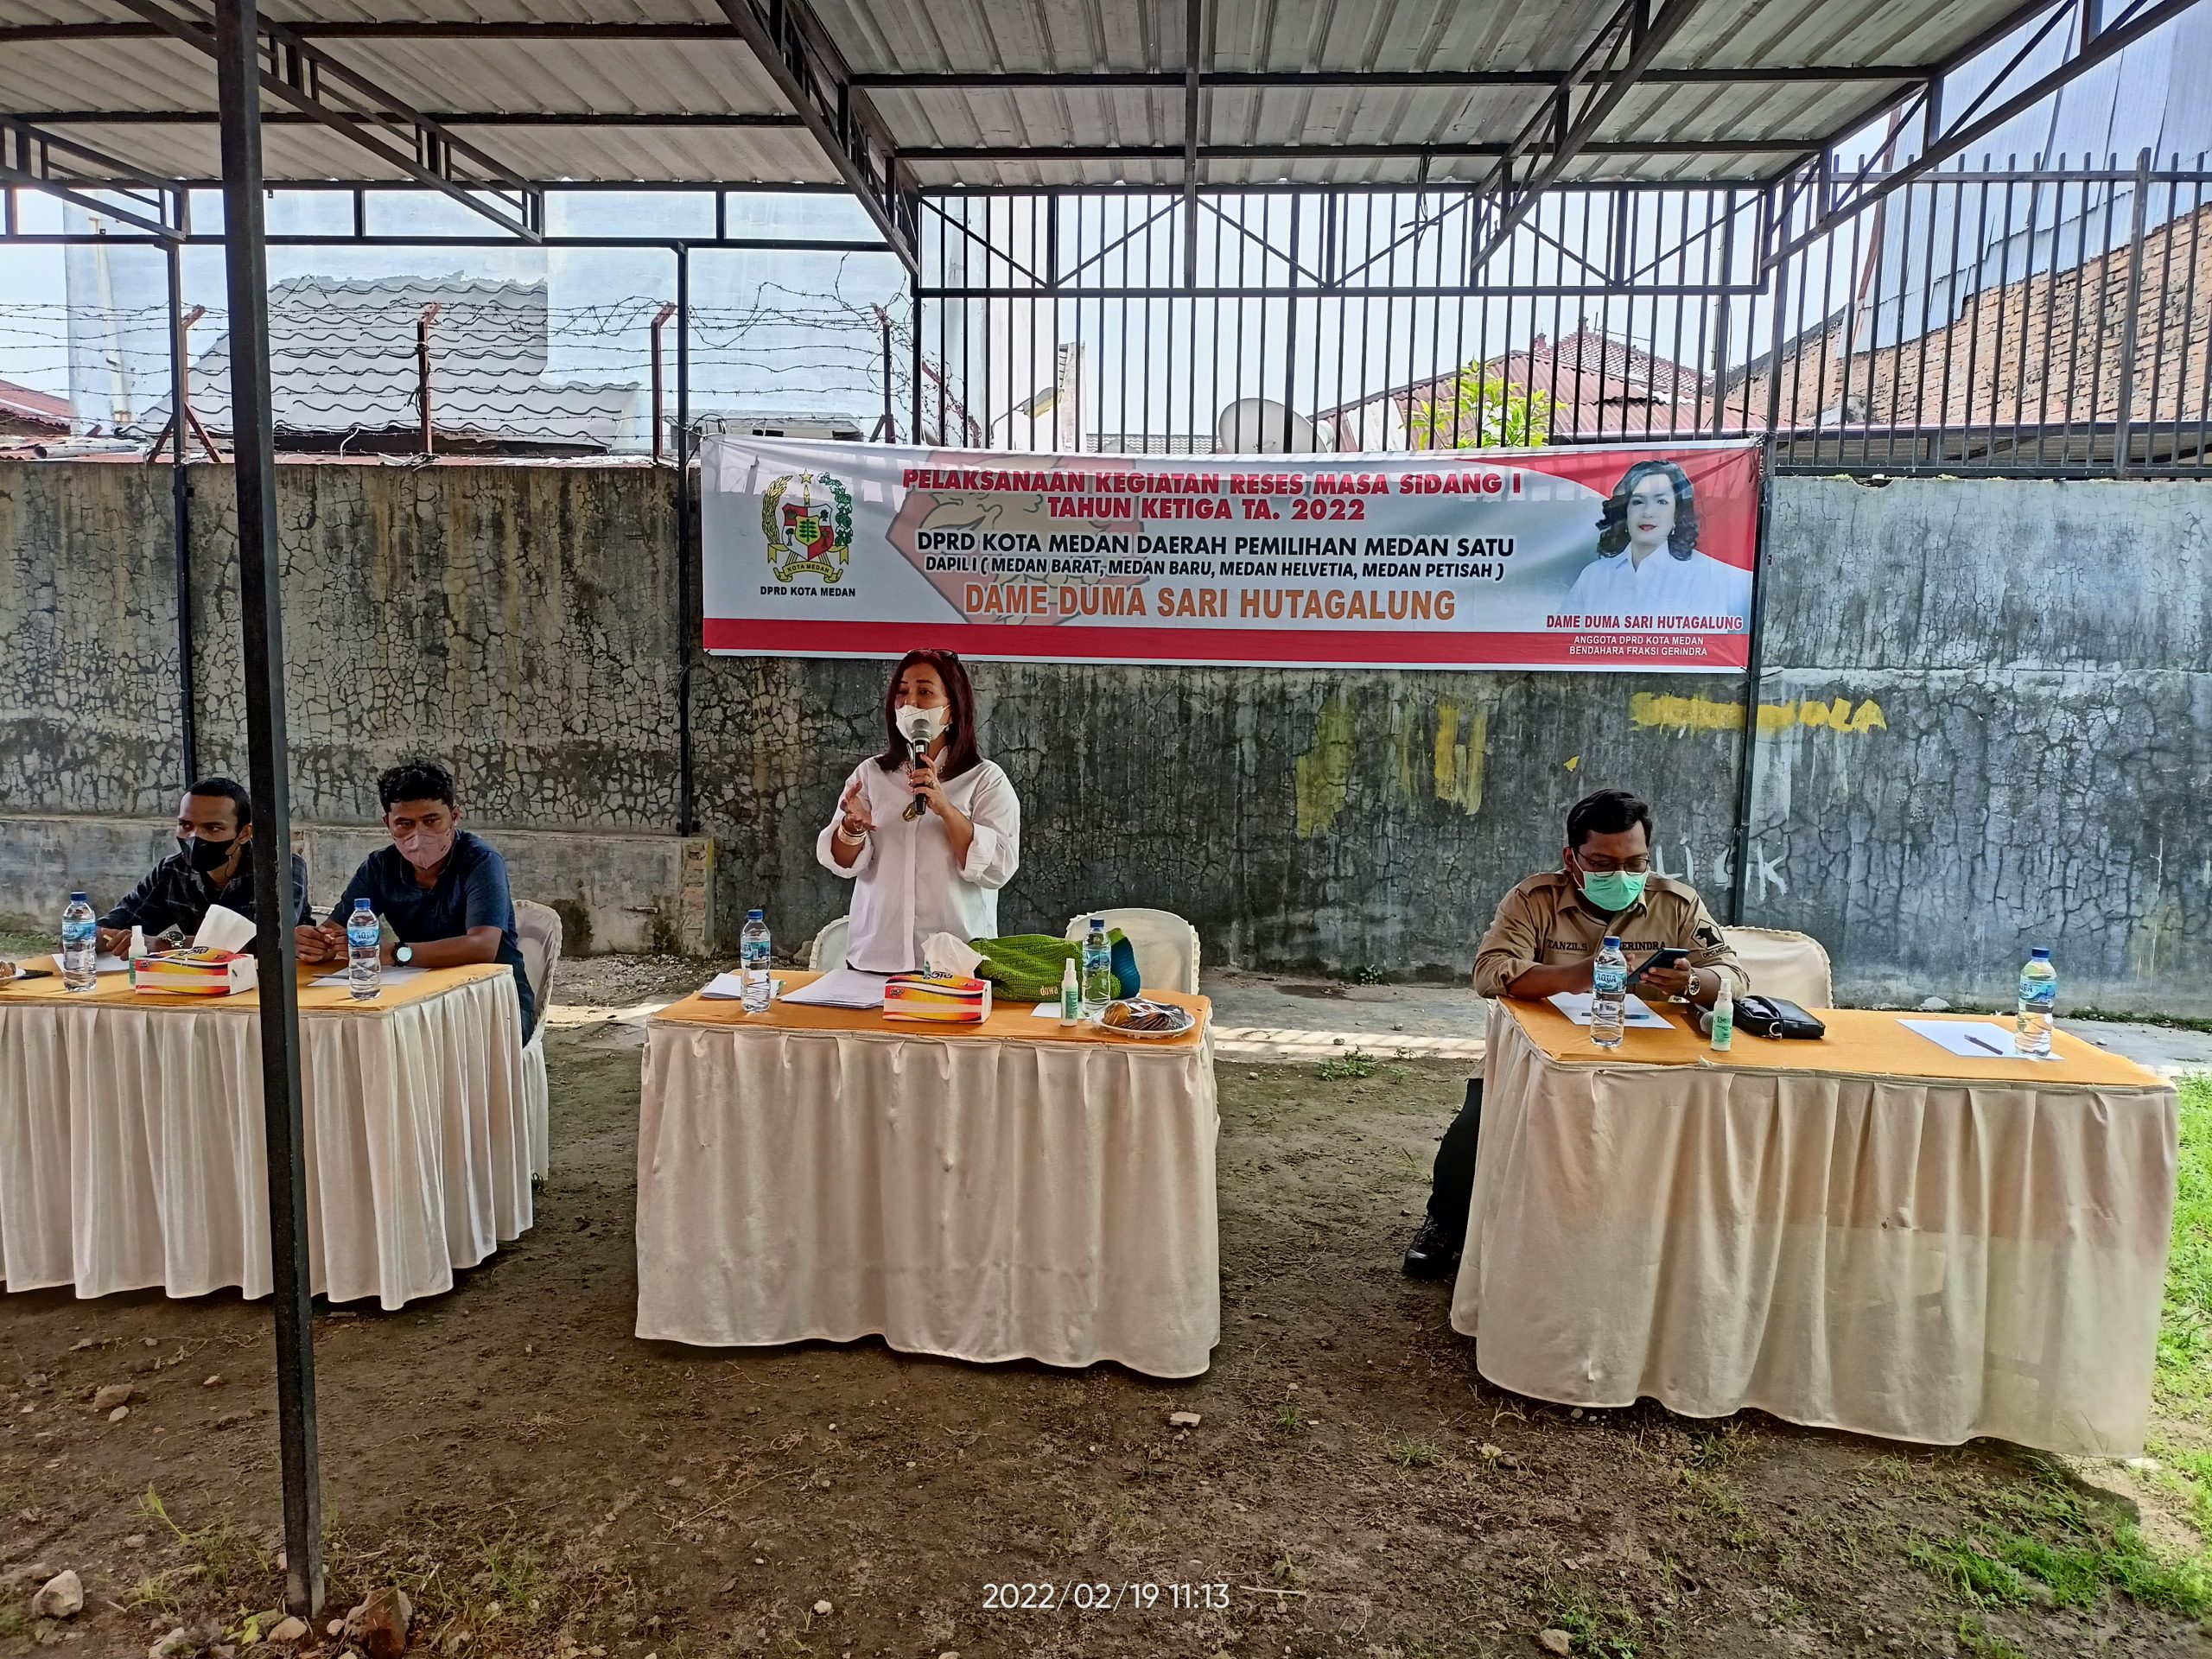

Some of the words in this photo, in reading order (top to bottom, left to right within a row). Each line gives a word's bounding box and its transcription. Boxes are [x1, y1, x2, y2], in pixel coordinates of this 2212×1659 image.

[903, 469, 1085, 493] PELAKSANAAN
[1095, 472, 1219, 494] KEGIATAN
[1230, 474, 1304, 494] RESES
[1313, 474, 1389, 495] MASA
[1399, 474, 1503, 495] SIDANG
[1513, 473, 1522, 493] I
[1047, 497, 1131, 518] TAHUN
[1141, 498, 1232, 519] KETIGA
[1242, 499, 1281, 520] TA.
[1291, 499, 1365, 520] 2022
[918, 531, 975, 550] DPRD
[982, 533, 1041, 552] KOTA
[1049, 534, 1128, 554] MEDAN
[1137, 536, 1227, 555] DAERAH
[1235, 537, 1357, 556] PEMILIHAN
[1364, 537, 1448, 556] MEDAN
[1457, 538, 1514, 557] SATU
[806, 564, 830, 573] MEDAN
[925, 556, 968, 571] DAPIL
[991, 557, 1047, 573] MEDAN
[1051, 558, 1104, 577] BARAT,
[1109, 559, 1165, 575] MEDAN
[1169, 560, 1216, 578] BARU,
[1219, 562, 1277, 576] MEDAN
[1281, 563, 1357, 580] HELVETIA,
[1362, 563, 1421, 577] MEDAN
[1426, 563, 1492, 578] PETISAH
[760, 586, 787, 595] DPRD
[791, 587, 817, 596] KOTA
[821, 588, 855, 597] MEDAN
[966, 584, 1047, 614] DAME
[1059, 586, 1147, 616] DUMA
[1157, 588, 1228, 617] SARI
[1240, 588, 1455, 620] HUTAGALUNG
[1547, 614, 1580, 628] DAME
[1585, 615, 1620, 629] DUMA
[1624, 615, 1653, 629] SARI
[1657, 616, 1743, 630] HUTAGALUNG
[1574, 635, 1616, 645] ANGGOTA
[1619, 636, 1643, 645] DPRD
[1672, 637, 1704, 645] MEDAN
[1569, 646, 1624, 655] BENDAHARA
[1627, 646, 1659, 655] FRAKSI
[1662, 647, 1707, 656] GERINDRA
[1619, 941, 1667, 951] ERINDRA
[1596, 973, 1617, 984] AQUA
[1039, 985, 1058, 996] dowa
